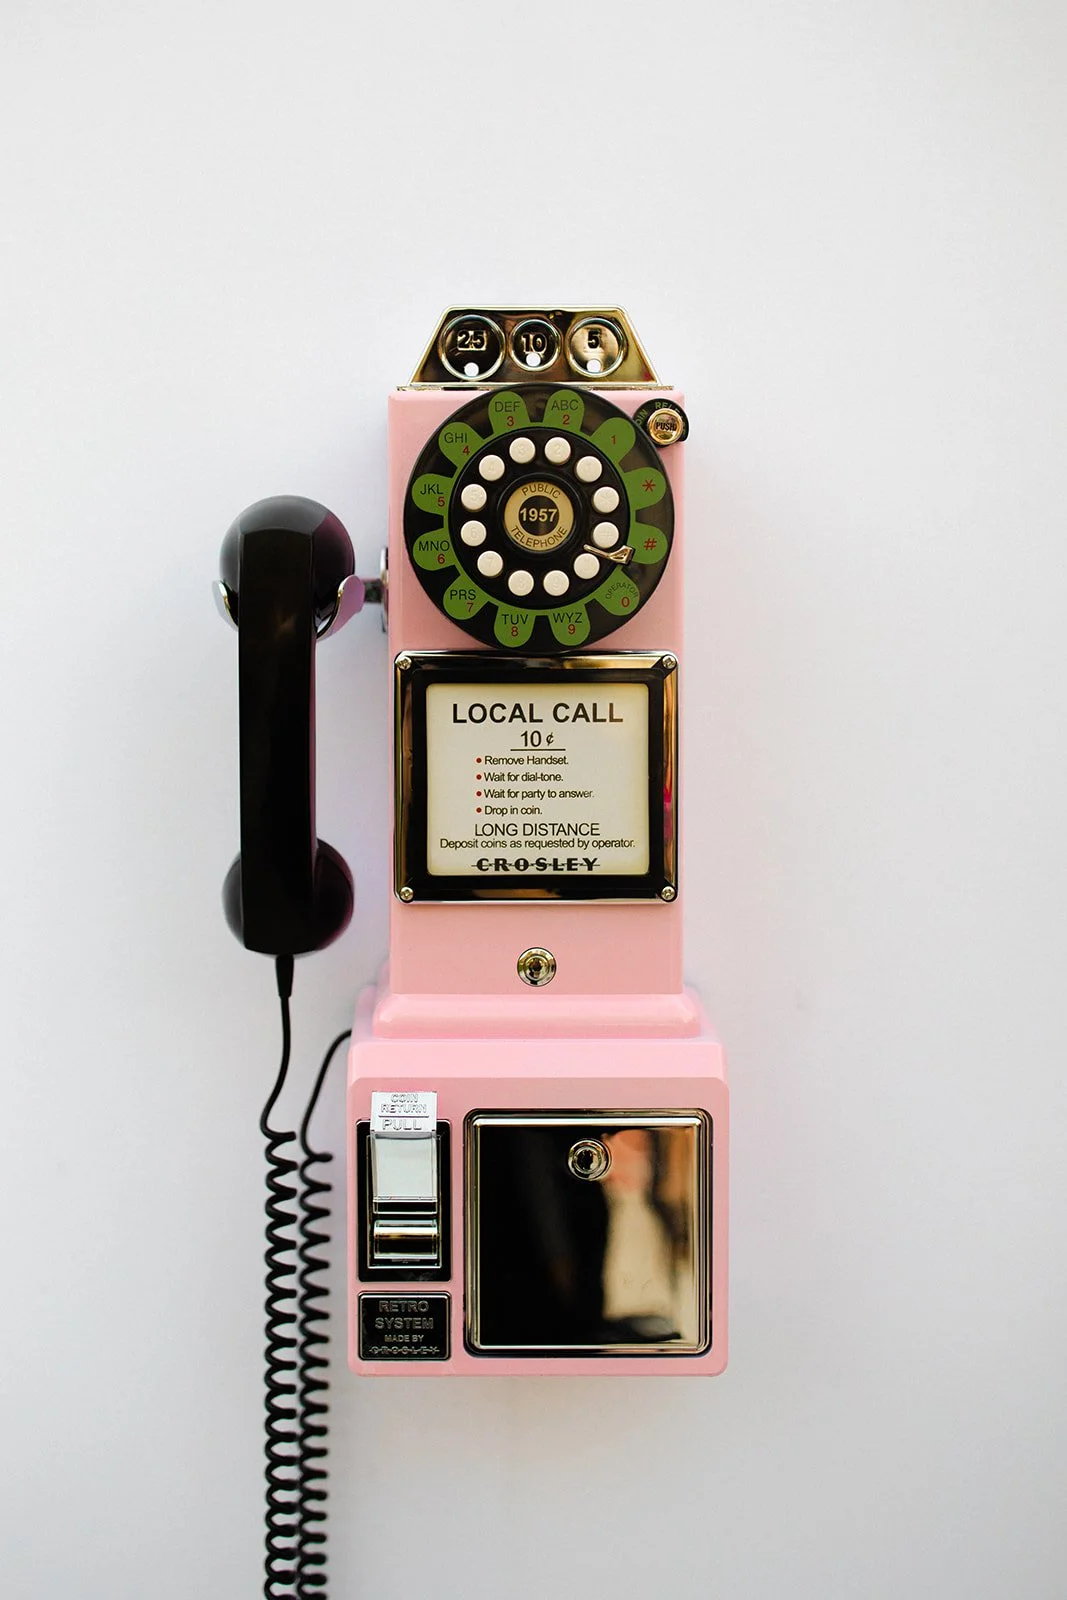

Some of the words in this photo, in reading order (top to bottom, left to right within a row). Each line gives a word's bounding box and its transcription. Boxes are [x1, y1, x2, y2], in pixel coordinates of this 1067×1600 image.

[457, 330, 486, 351] 25
[521, 332, 547, 353] 10
[587, 330, 601, 350] 5
[494, 401, 521, 412] DEF
[551, 399, 579, 410] ABC
[506, 415, 515, 427] 3
[562, 413, 570, 425] 2
[655, 421, 677, 432] PUSH
[444, 432, 468, 443] GHI
[611, 434, 616, 445] 1
[462, 445, 470, 456] 4
[420, 483, 444, 495] JKL
[521, 483, 561, 499] PUBLIC
[437, 496, 445, 507] 5
[519, 507, 558, 522] 1957
[511, 525, 568, 548] TELEPHONE
[418, 540, 450, 552] MNO
[643, 537, 657, 550] #
[437, 553, 445, 565] 6
[450, 589, 477, 601] PRS
[605, 582, 639, 600] OPERATOR
[466, 602, 474, 613] 7
[621, 596, 630, 608] 0
[501, 614, 529, 625] TUV
[552, 612, 583, 624] WYZ
[511, 625, 519, 637] 8
[567, 623, 576, 635] 9
[452, 703, 544, 724] LOCAL
[552, 702, 624, 723] CALL
[520, 730, 542, 747] 10
[484, 755, 525, 765] Remove
[527, 755, 569, 765] Handset.
[484, 772, 506, 782] Wait
[507, 772, 520, 782] for
[521, 772, 564, 782] dial-tone.
[484, 789, 506, 799] Wait
[507, 788, 520, 799] for
[521, 789, 546, 800] party
[547, 789, 557, 799] to
[558, 790, 595, 799] answer.
[484, 805, 508, 817] Drop
[510, 805, 519, 815] in
[520, 805, 543, 815] coin.
[475, 823, 518, 837] LONG
[522, 822, 601, 836] DISTANCE
[440, 838, 479, 850] Deposit
[481, 838, 507, 849] coins
[509, 839, 522, 849] as
[524, 838, 575, 850] requested
[577, 838, 590, 850] by
[591, 838, 636, 850] operator.
[475, 857, 599, 872] CROSLEY
[390, 1093, 419, 1103] COIN
[381, 1103, 427, 1113] RETURN
[382, 1119, 422, 1130] PULL
[378, 1300, 430, 1312] RETRO
[374, 1317, 434, 1329] SYSTEM
[384, 1334, 410, 1342] MADE
[411, 1334, 424, 1342] BY
